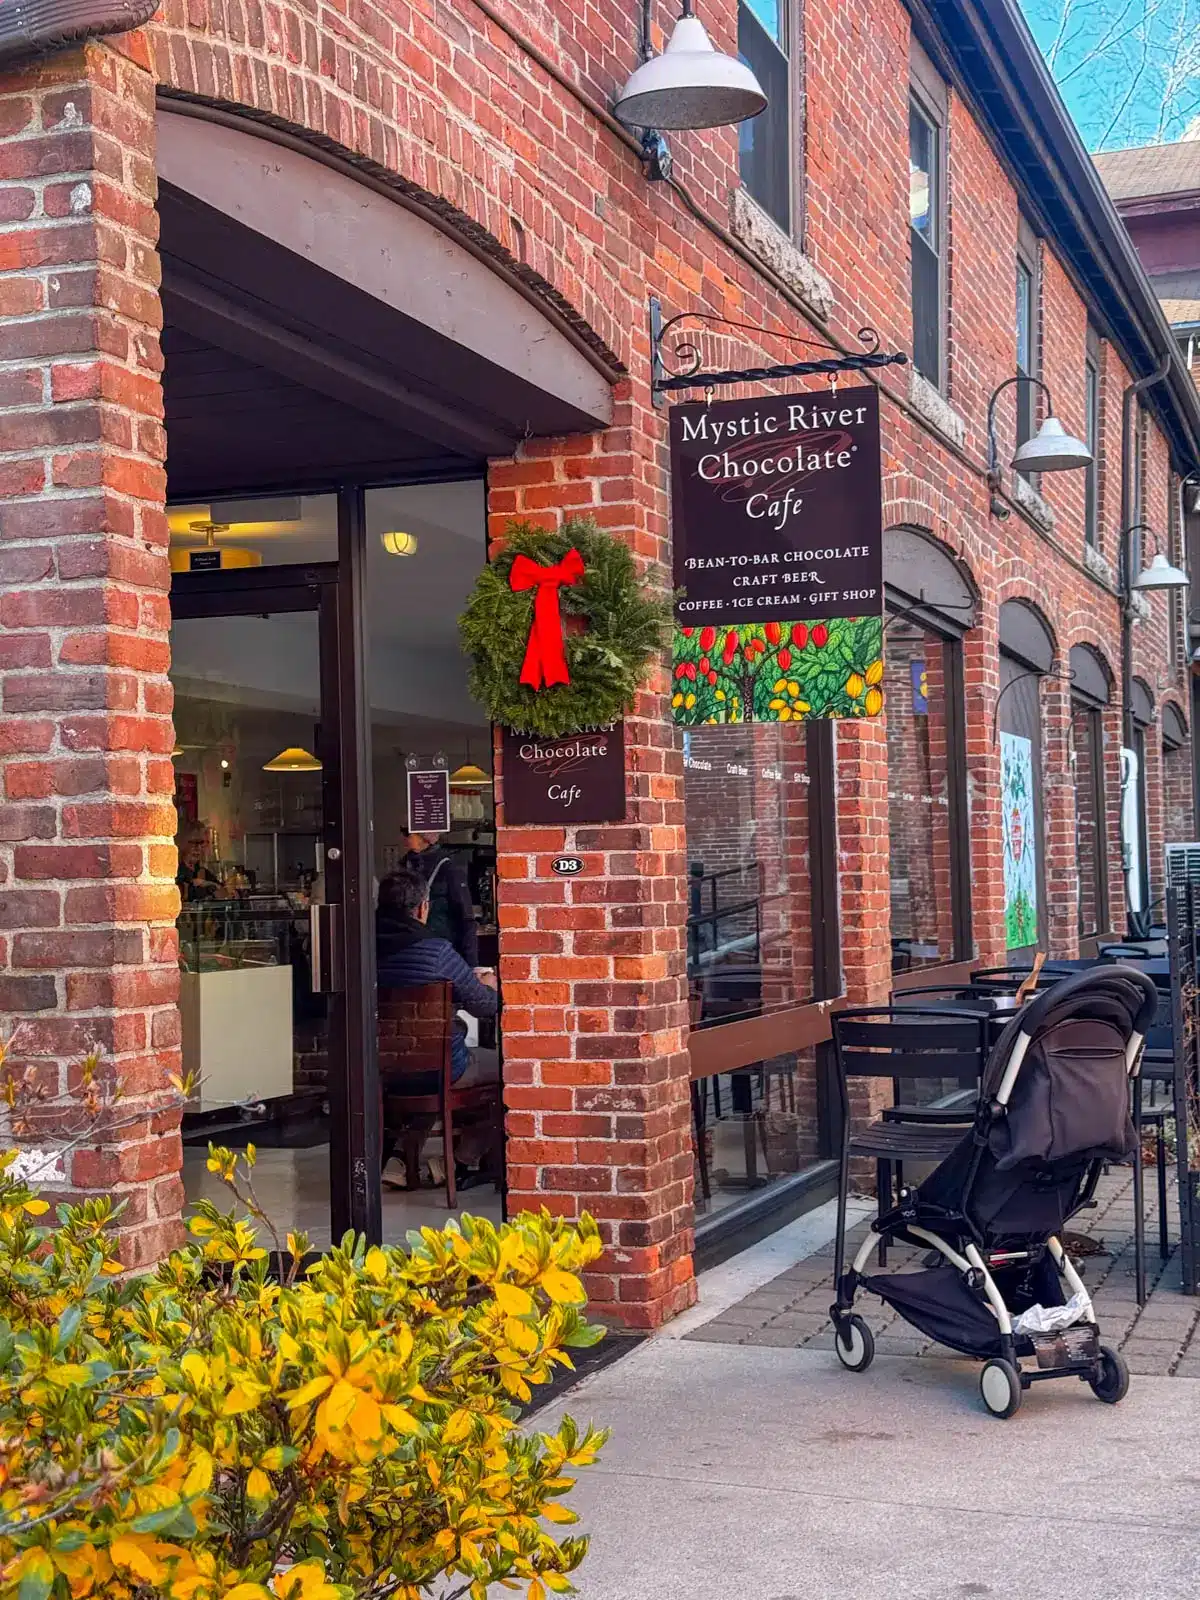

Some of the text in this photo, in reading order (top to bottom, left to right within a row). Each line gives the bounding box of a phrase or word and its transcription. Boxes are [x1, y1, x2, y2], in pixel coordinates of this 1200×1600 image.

[680, 404, 867, 444] Mystic River
[697, 445, 852, 480] Chocolate
[745, 488, 803, 531] Cafe
[684, 546, 870, 570] BEAN-TO-BAR CHOCOLATE
[733, 571, 826, 587] CRAFT BEER
[678, 589, 877, 611] COFFEE ICE CREAM GIFT SHOP
[519, 742, 608, 760] Chocolate
[689, 757, 712, 772] Chocolate
[726, 763, 738, 775] Craft
[547, 784, 582, 807] Cafe
[558, 860, 578, 871] D3
